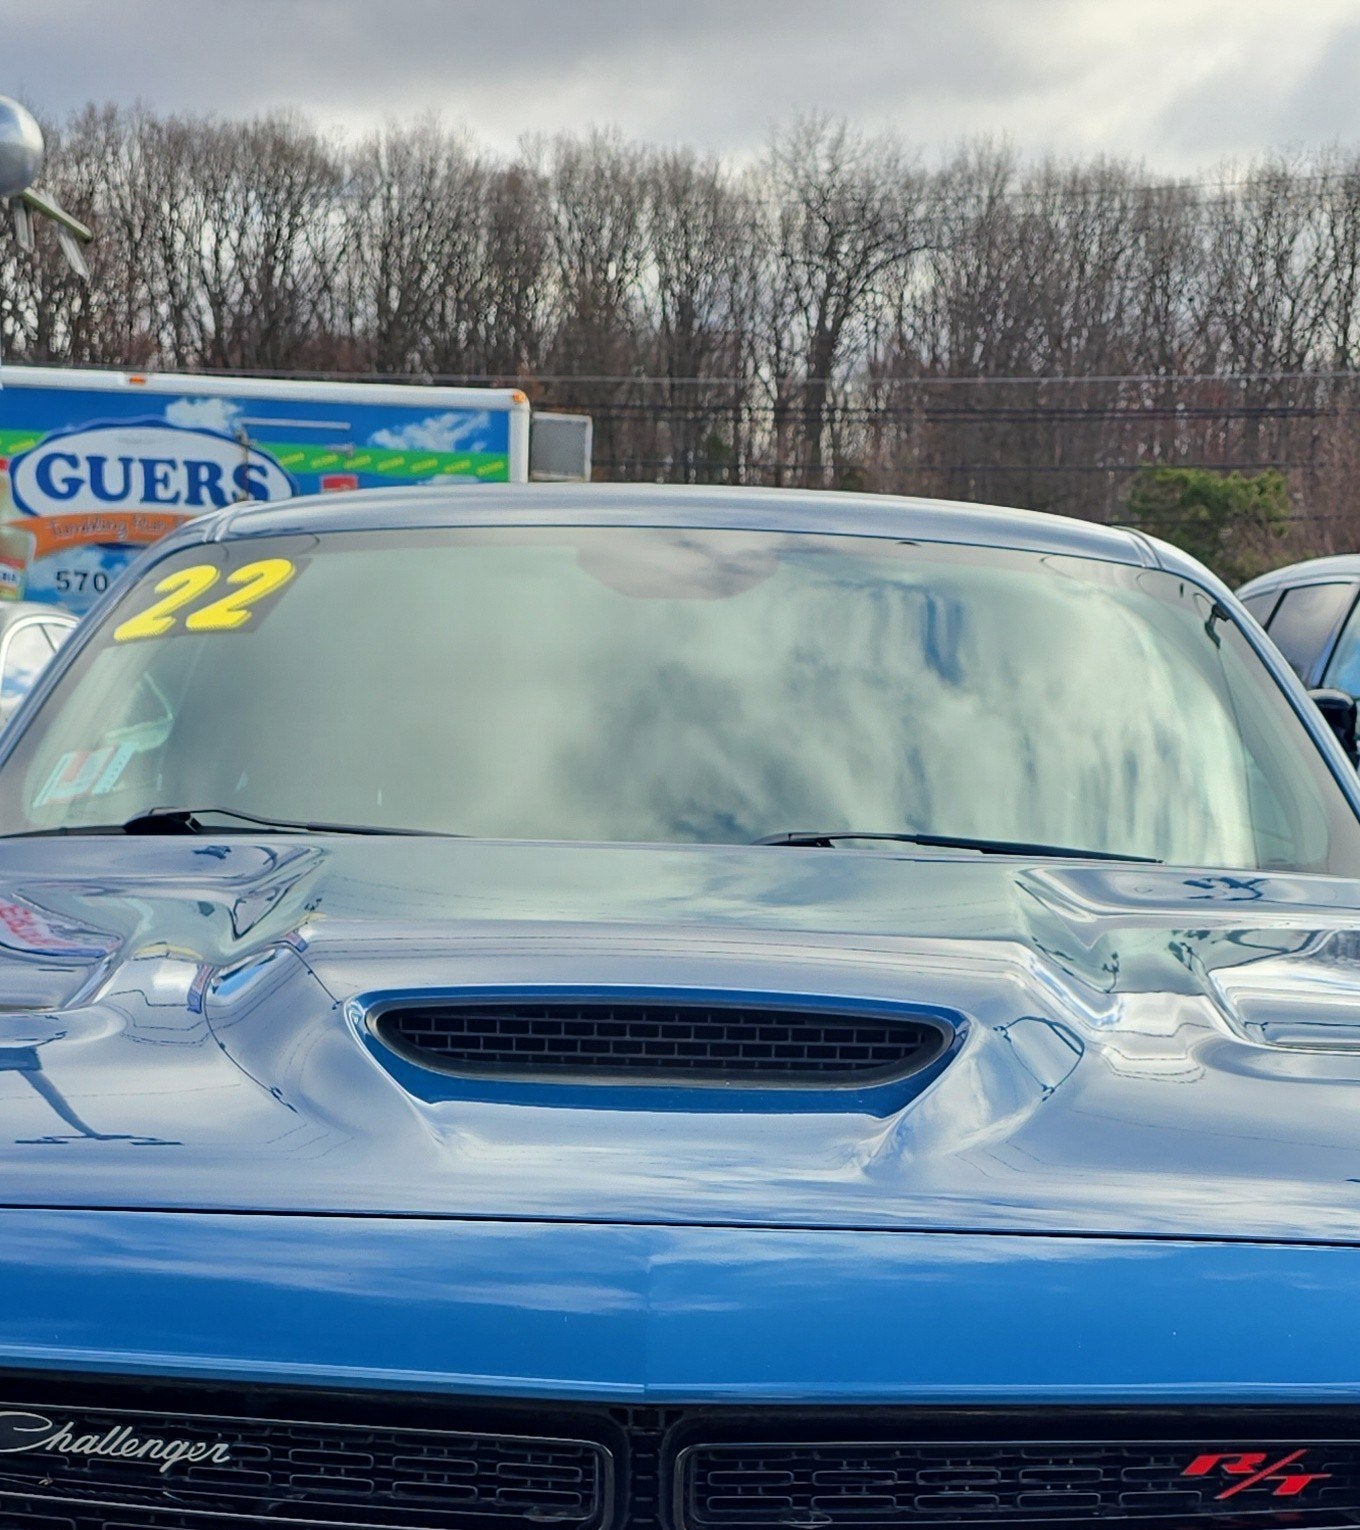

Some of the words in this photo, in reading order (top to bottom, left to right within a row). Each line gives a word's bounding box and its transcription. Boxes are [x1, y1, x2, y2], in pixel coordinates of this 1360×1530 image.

[35, 453, 270, 508] GUERS
[56, 569, 109, 594] 570
[114, 559, 296, 642] 22
[1180, 1449, 1332, 1500] R/T
